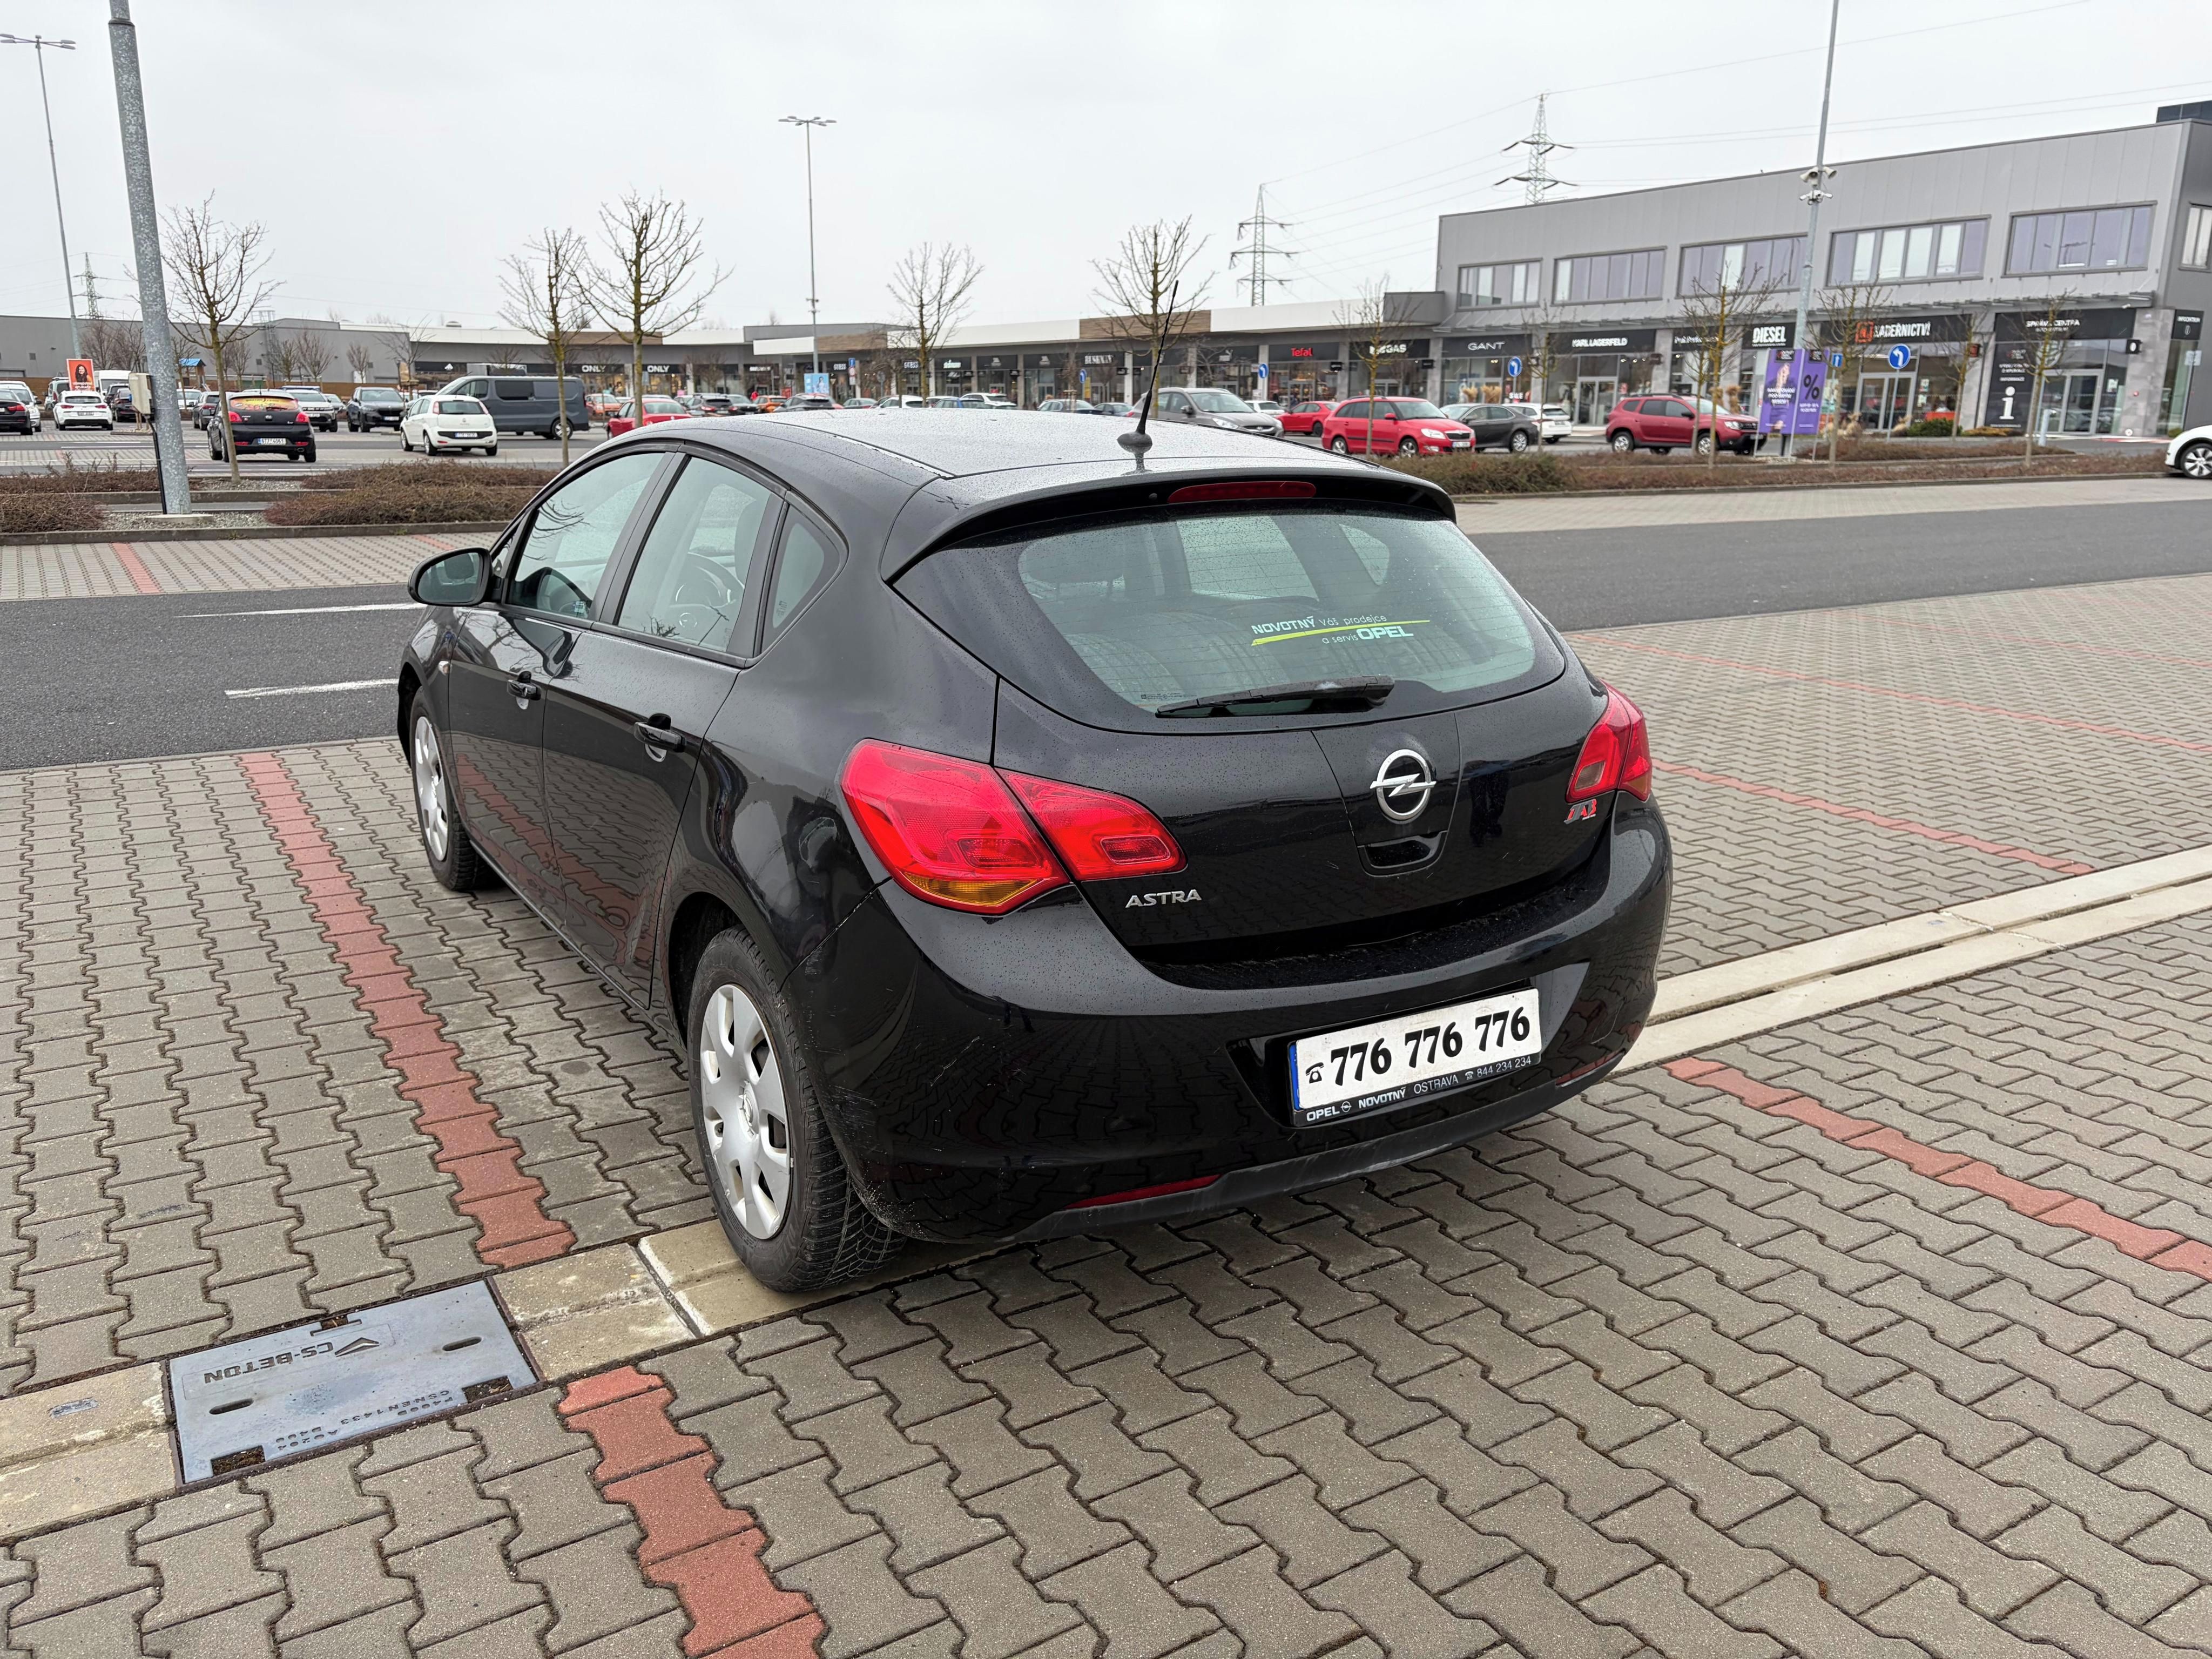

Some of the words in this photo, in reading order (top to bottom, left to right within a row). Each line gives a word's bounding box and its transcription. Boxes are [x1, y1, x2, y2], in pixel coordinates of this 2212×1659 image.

[1589, 337, 1628, 347] LAGERFELD
[1752, 326, 1786, 343] DIESEL
[1291, 347, 1313, 357] Tefal
[1467, 341, 1506, 350] GANT
[582, 365, 606, 373] ONLY
[1251, 615, 1314, 635] NOVOTNÝ
[1319, 618, 1339, 626] Váš
[1343, 615, 1387, 626] prodejce
[1332, 634, 1358, 644] servis
[1356, 625, 1414, 640] OPEL
[1125, 889, 1202, 908] ASTRA
[1331, 1037, 1392, 1086] 776
[1405, 1021, 1462, 1068] 776
[1475, 1006, 1530, 1052] 776
[1306, 1105, 1340, 1122] OPEL
[1358, 1086, 1406, 1109] NOVOTNÝ
[1413, 1074, 1459, 1094] OSTRAVA
[1476, 1065, 1493, 1078] 844
[1495, 1061, 1513, 1073] 234
[1515, 1055, 1532, 1068] 234
[204, 1341, 334, 1384] CS-BETON
